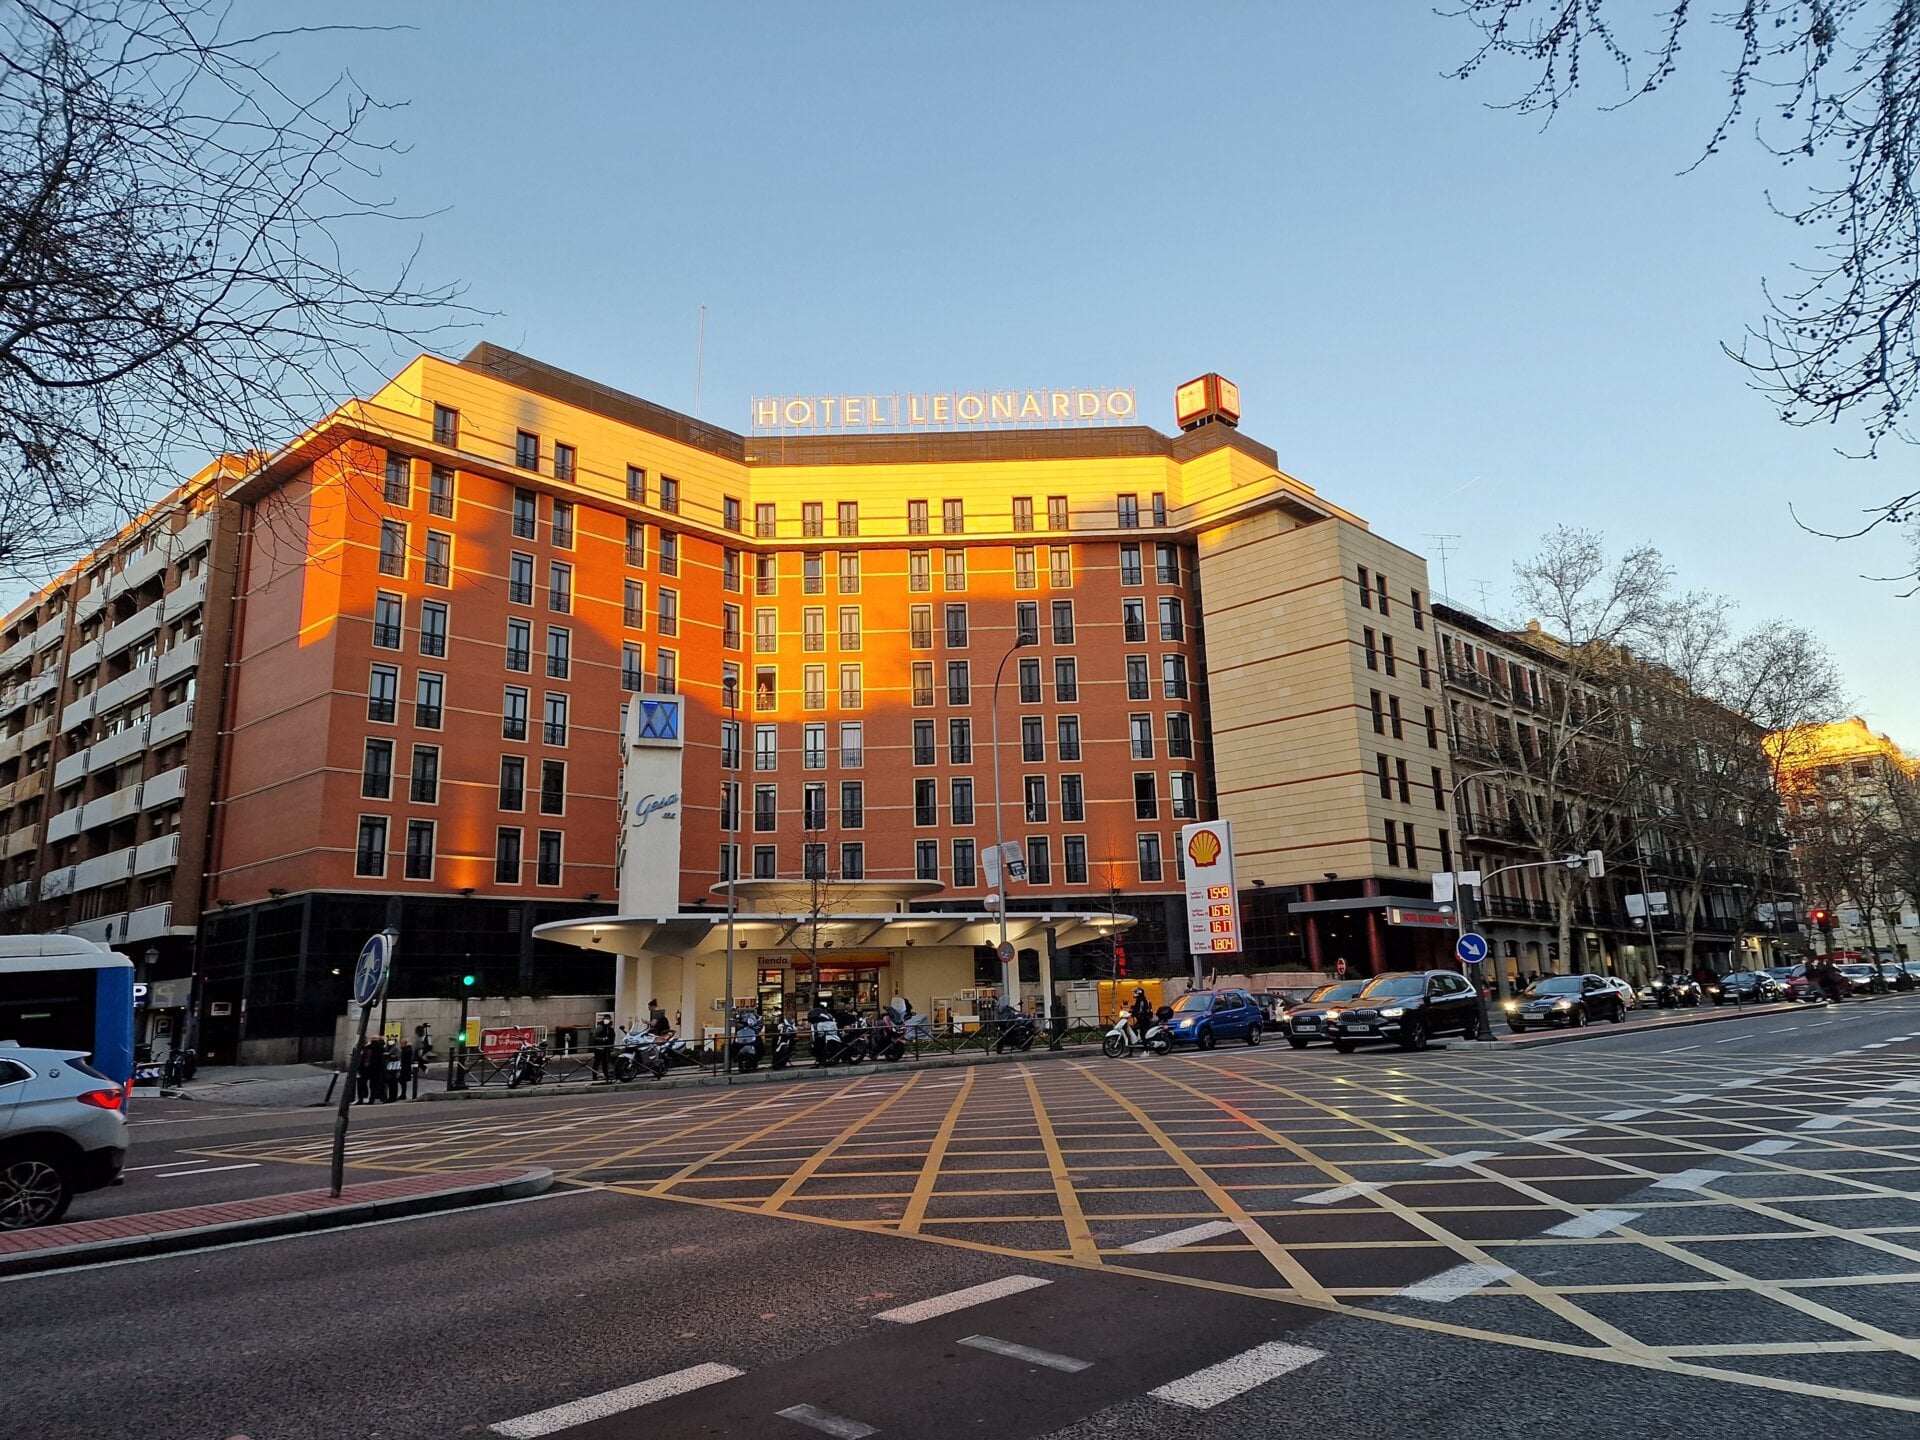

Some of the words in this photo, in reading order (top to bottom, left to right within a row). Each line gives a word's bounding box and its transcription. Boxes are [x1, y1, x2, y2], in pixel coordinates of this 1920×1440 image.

[758, 399, 885, 425] HOTEL
[911, 391, 1133, 422] LEONARDO
[758, 956, 788, 965] Tienda
[133, 985, 148, 1001] P
